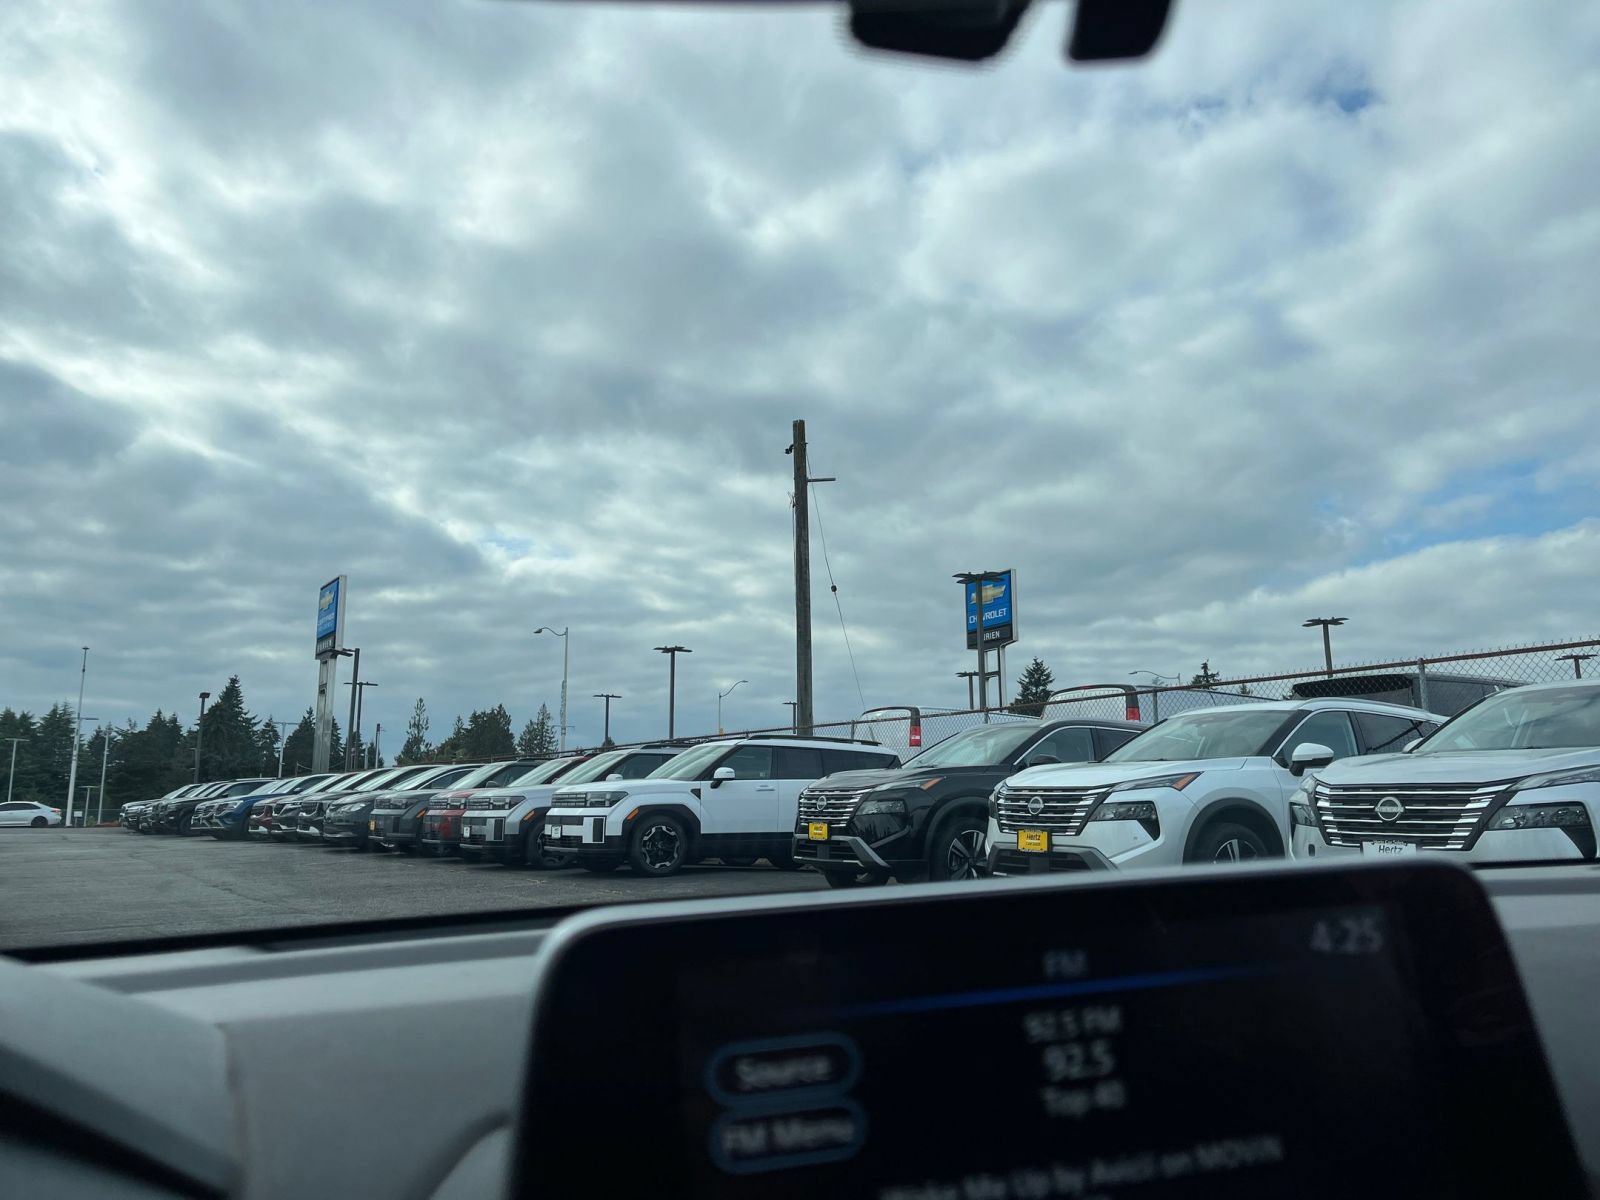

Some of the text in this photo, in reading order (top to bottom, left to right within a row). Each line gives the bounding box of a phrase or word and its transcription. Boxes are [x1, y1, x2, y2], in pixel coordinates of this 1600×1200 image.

[969, 608, 1007, 624] CHVROLET
[1378, 845, 1403, 853] Hertz
[1311, 917, 1384, 953] 4:25
[1042, 949, 1087, 976] FM
[1080, 1003, 1123, 1034] FM
[735, 1054, 832, 1091] Source
[1042, 1036, 1117, 1081] 92.5
[721, 1114, 856, 1154] FM Menu
